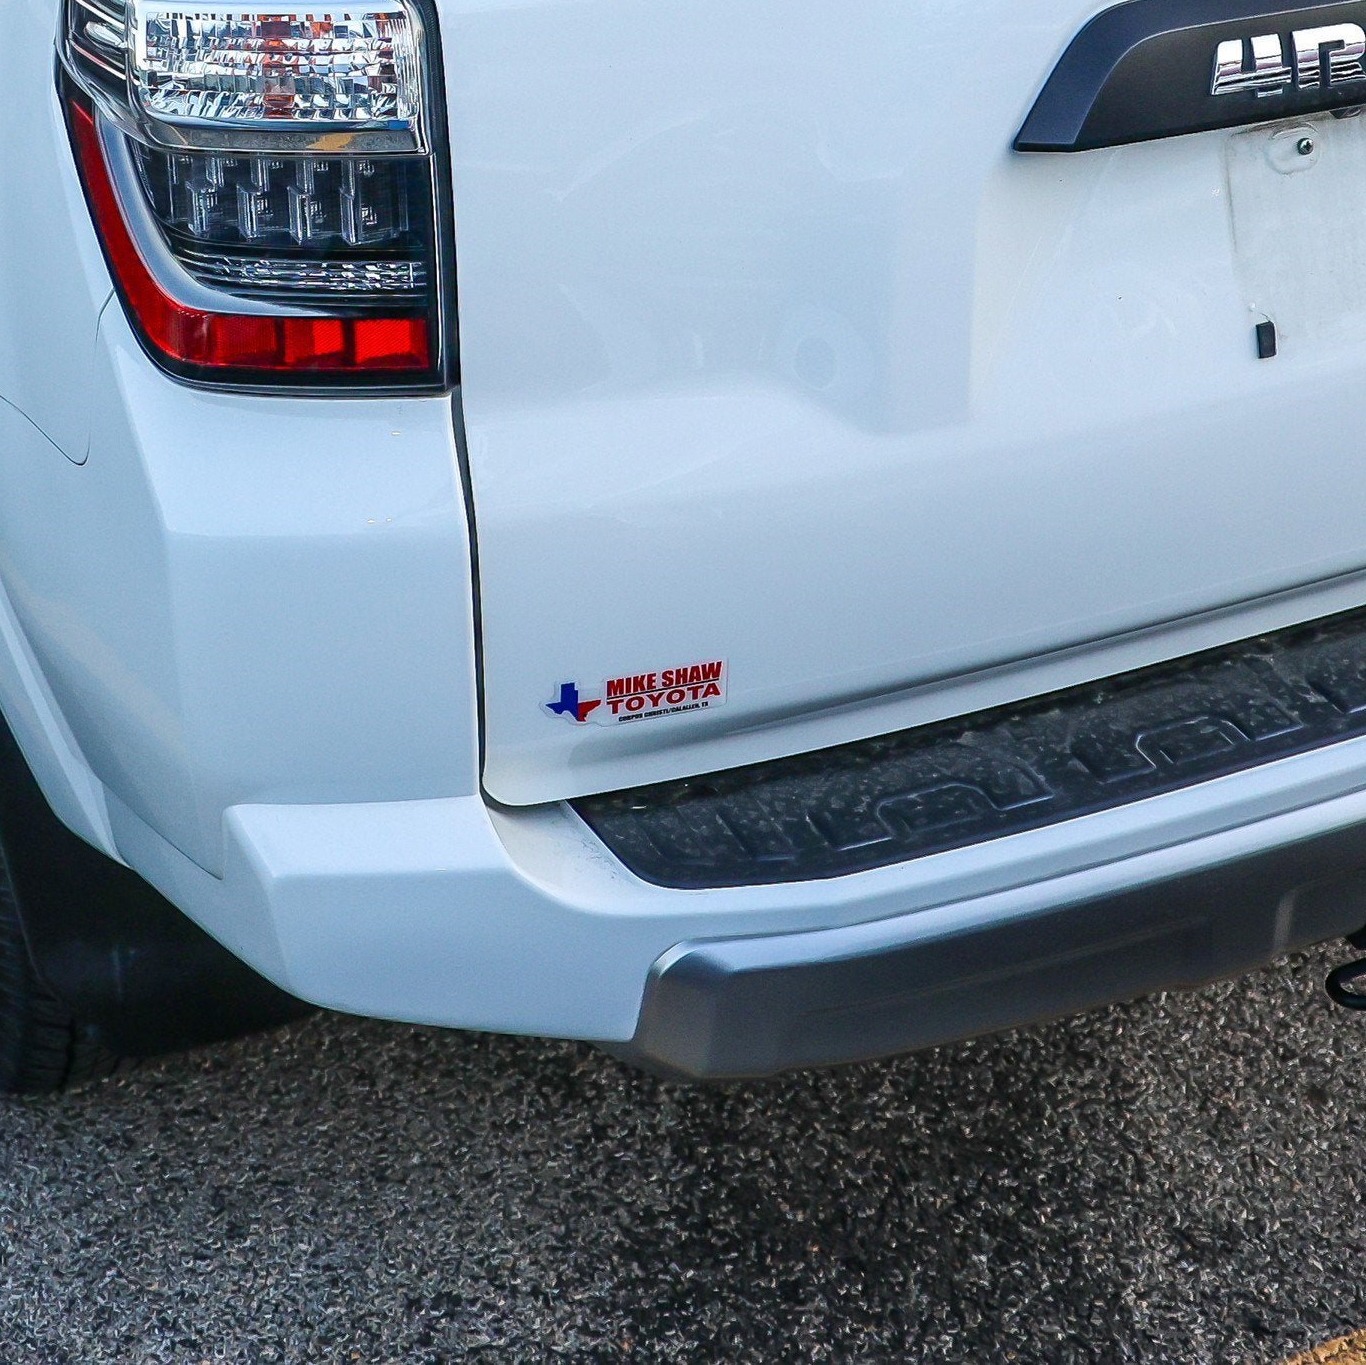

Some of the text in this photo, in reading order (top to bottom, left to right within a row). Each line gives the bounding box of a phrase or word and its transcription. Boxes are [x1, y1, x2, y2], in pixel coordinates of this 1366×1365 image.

[607, 661, 722, 697] MIKE SHAW
[607, 683, 720, 714] TOYOTA
